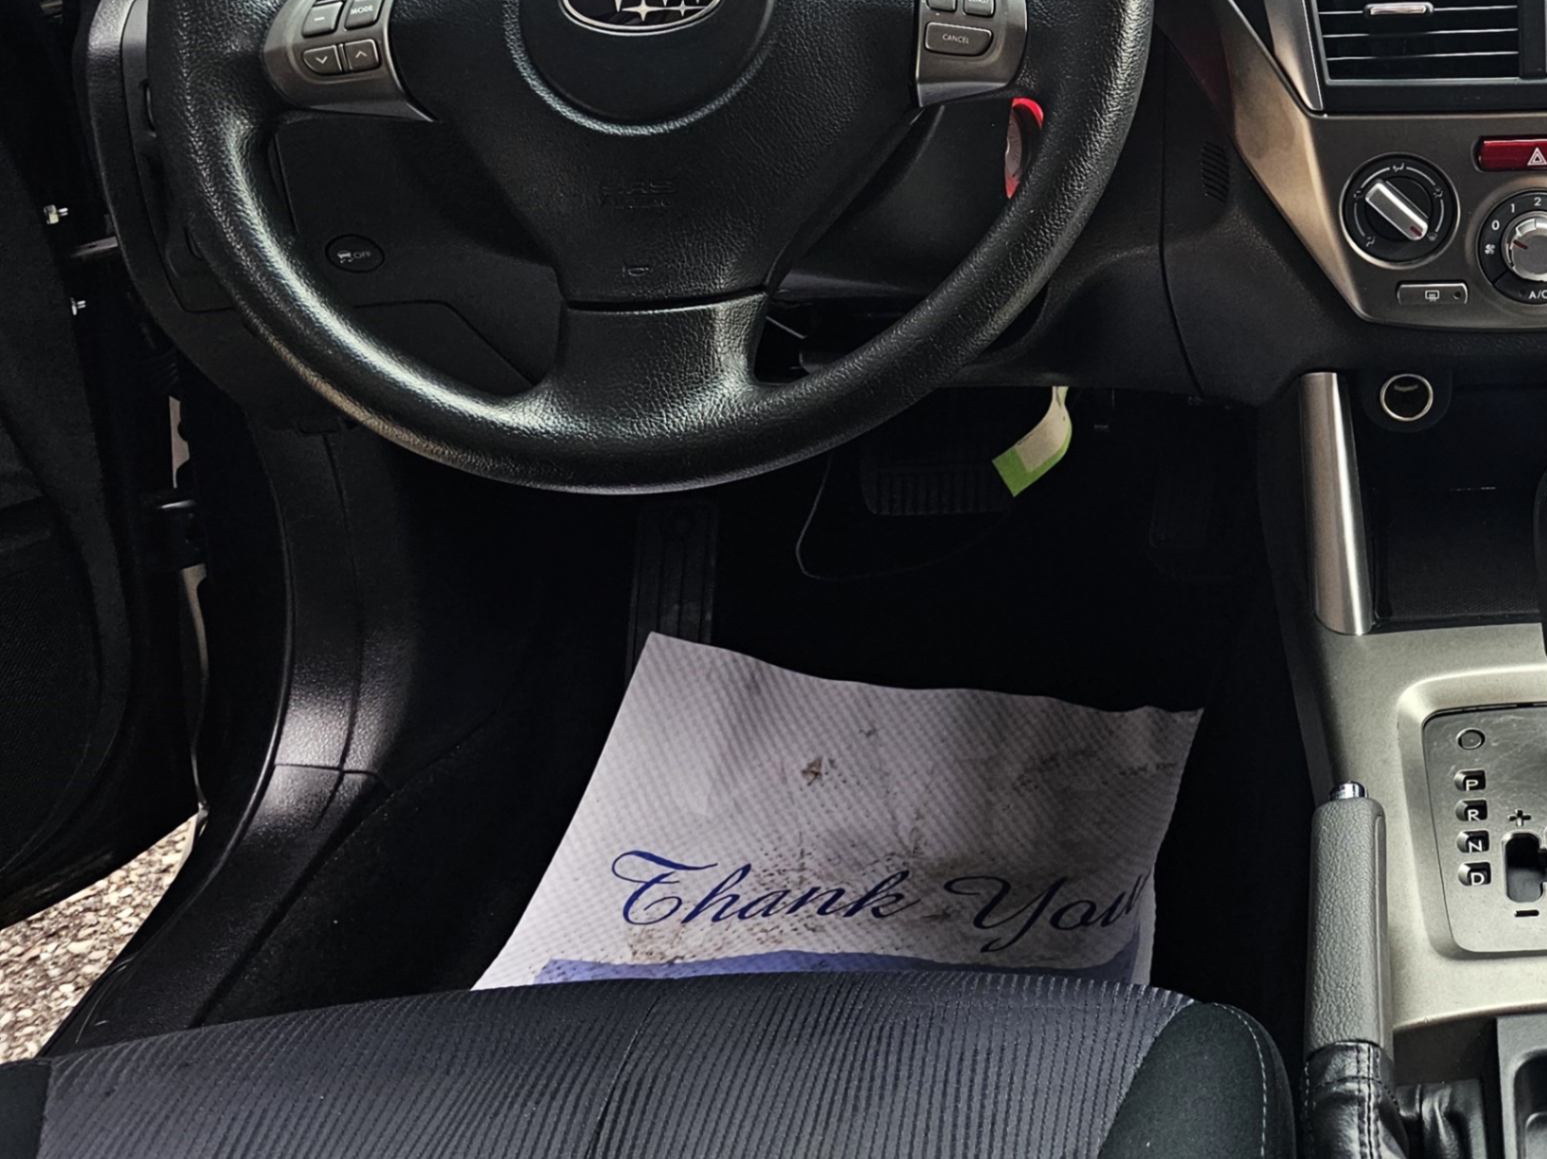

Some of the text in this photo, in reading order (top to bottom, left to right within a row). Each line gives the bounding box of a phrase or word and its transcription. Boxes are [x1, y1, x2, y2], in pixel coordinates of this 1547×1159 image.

[350, 5, 374, 15] MODE
[942, 33, 970, 44] CANCEL
[1534, 197, 1542, 206] 2
[1510, 203, 1515, 213] 1
[1491, 220, 1500, 230] 0
[1466, 779, 1479, 792] P
[1467, 809, 1480, 822] R
[1468, 839, 1482, 853] N
[1470, 872, 1485, 886] D
[611, 850, 1152, 954] Thank You
